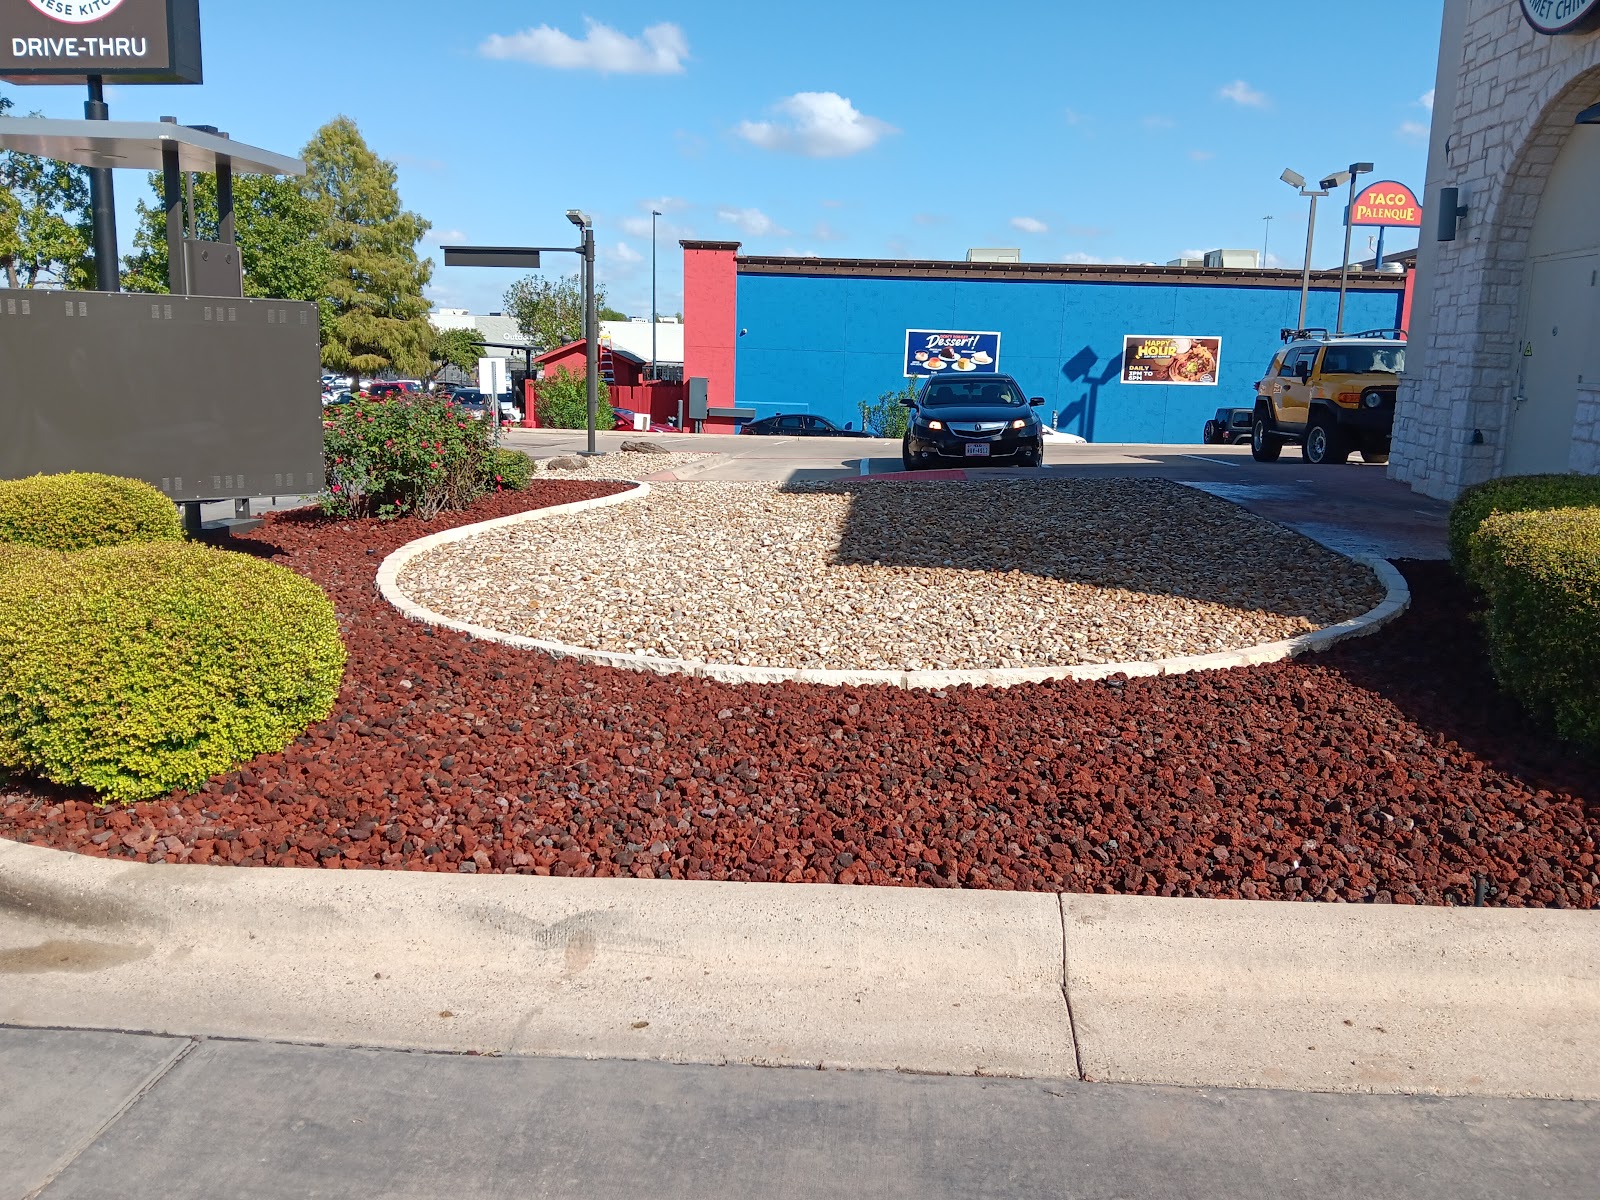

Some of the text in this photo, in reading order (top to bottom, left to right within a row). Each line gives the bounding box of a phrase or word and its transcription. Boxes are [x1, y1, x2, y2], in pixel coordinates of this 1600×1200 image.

[40, 0, 73, 15] ESE
[12, 37, 147, 57] DRIVE-THRU
[1369, 193, 1406, 206] TACO
[1356, 205, 1415, 221] PALENQUE
[925, 334, 980, 350] Dessert!
[1138, 345, 1177, 357] HOUR
